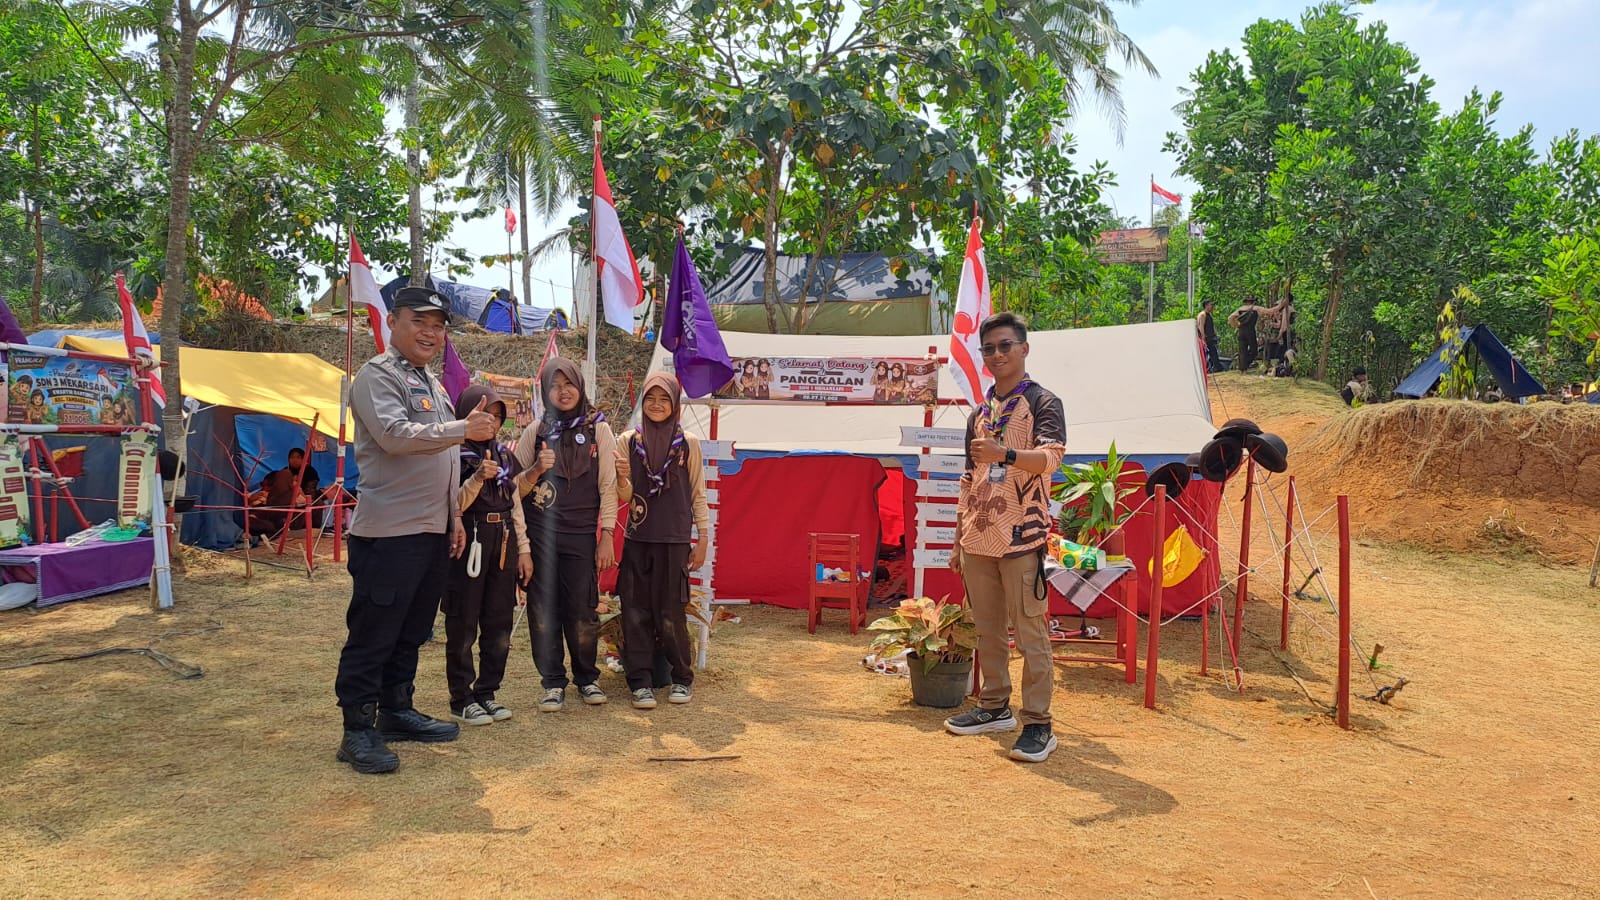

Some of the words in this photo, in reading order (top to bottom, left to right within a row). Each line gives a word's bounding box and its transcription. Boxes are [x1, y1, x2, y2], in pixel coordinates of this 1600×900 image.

[779, 359, 824, 369] Selamat
[827, 360, 867, 373] Datang
[35, 377, 53, 387] SDN
[54, 378, 59, 387] 3
[60, 378, 109, 393] MEKARSARI
[780, 375, 864, 386] PANGKALAN
